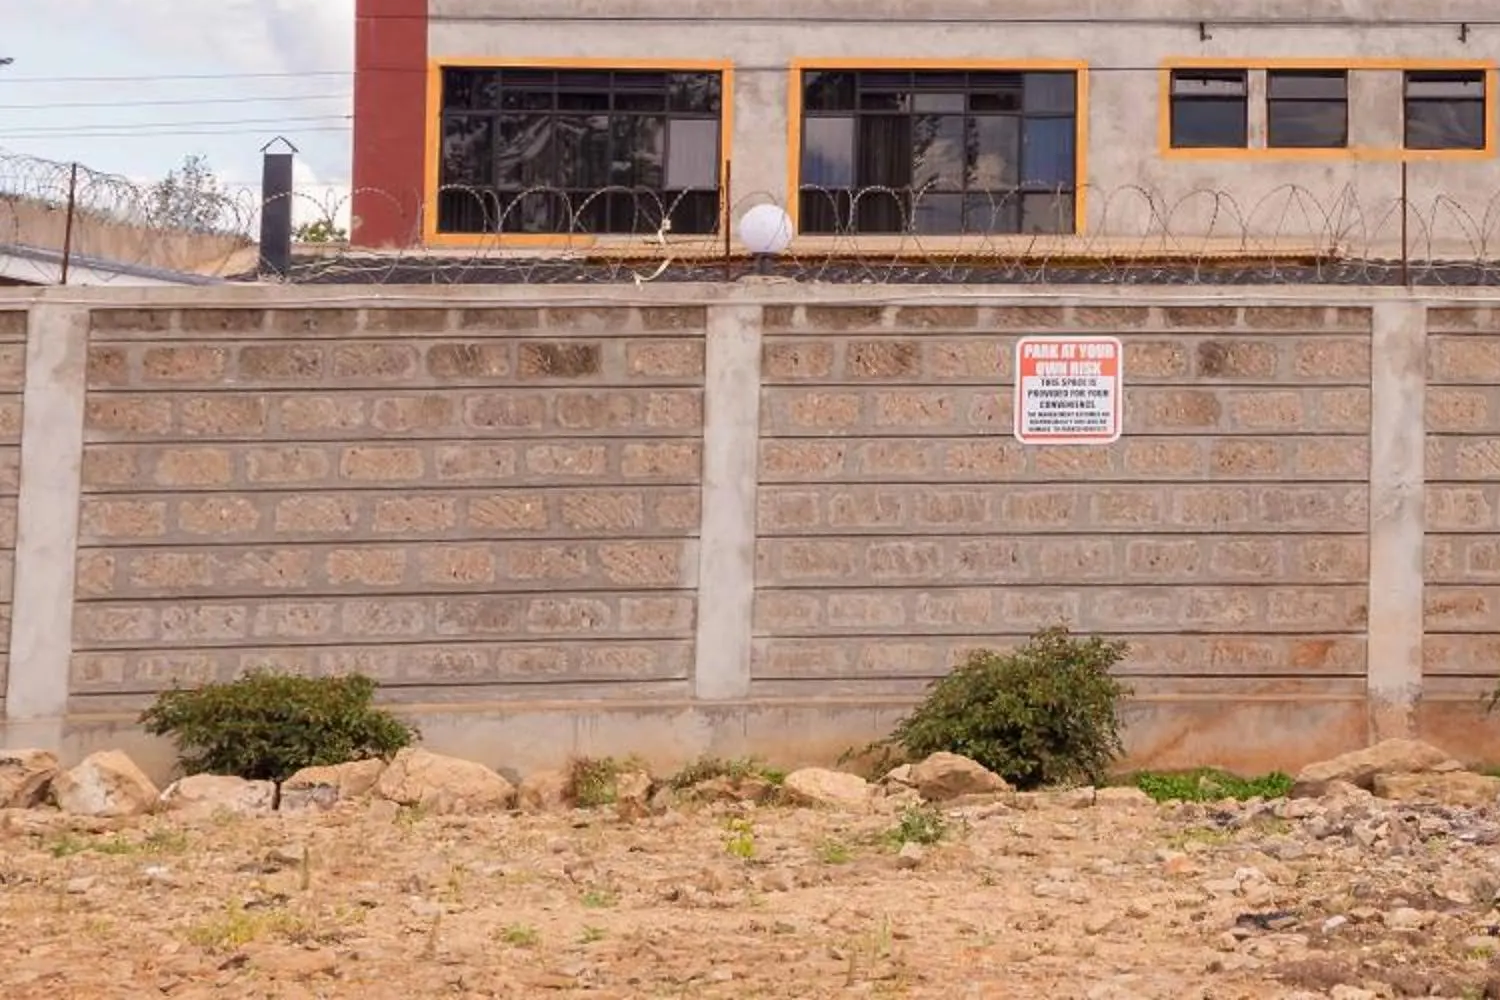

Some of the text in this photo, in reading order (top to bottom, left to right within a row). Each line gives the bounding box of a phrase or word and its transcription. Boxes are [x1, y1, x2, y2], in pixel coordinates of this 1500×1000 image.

[1024, 343, 1116, 359] PARK AT YOUR
